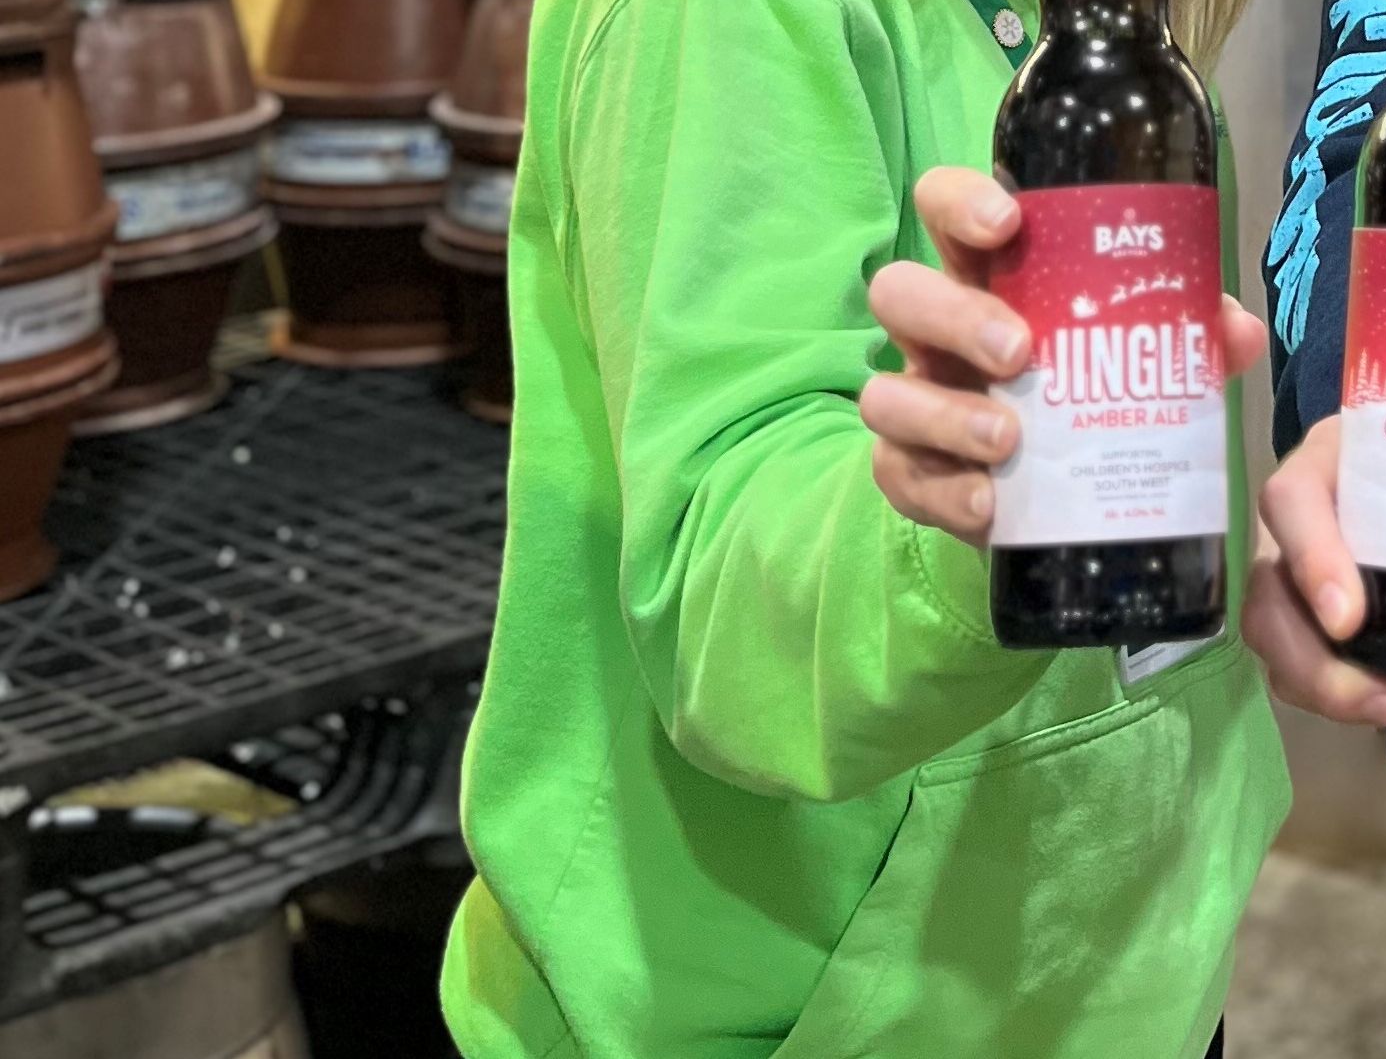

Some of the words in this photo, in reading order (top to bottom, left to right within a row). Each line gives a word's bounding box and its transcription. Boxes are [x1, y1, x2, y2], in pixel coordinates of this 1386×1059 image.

[1094, 224, 1164, 253] BAYS
[1044, 323, 1206, 406] JINGLE
[1072, 407, 1147, 429] AMBER
[1153, 405, 1190, 425] ALE
[1070, 463, 1141, 478] CHILDREN'S
[1143, 460, 1190, 474] HOSPICE
[1094, 478, 1137, 491] SOUTH
[1140, 476, 1171, 488] WEST
